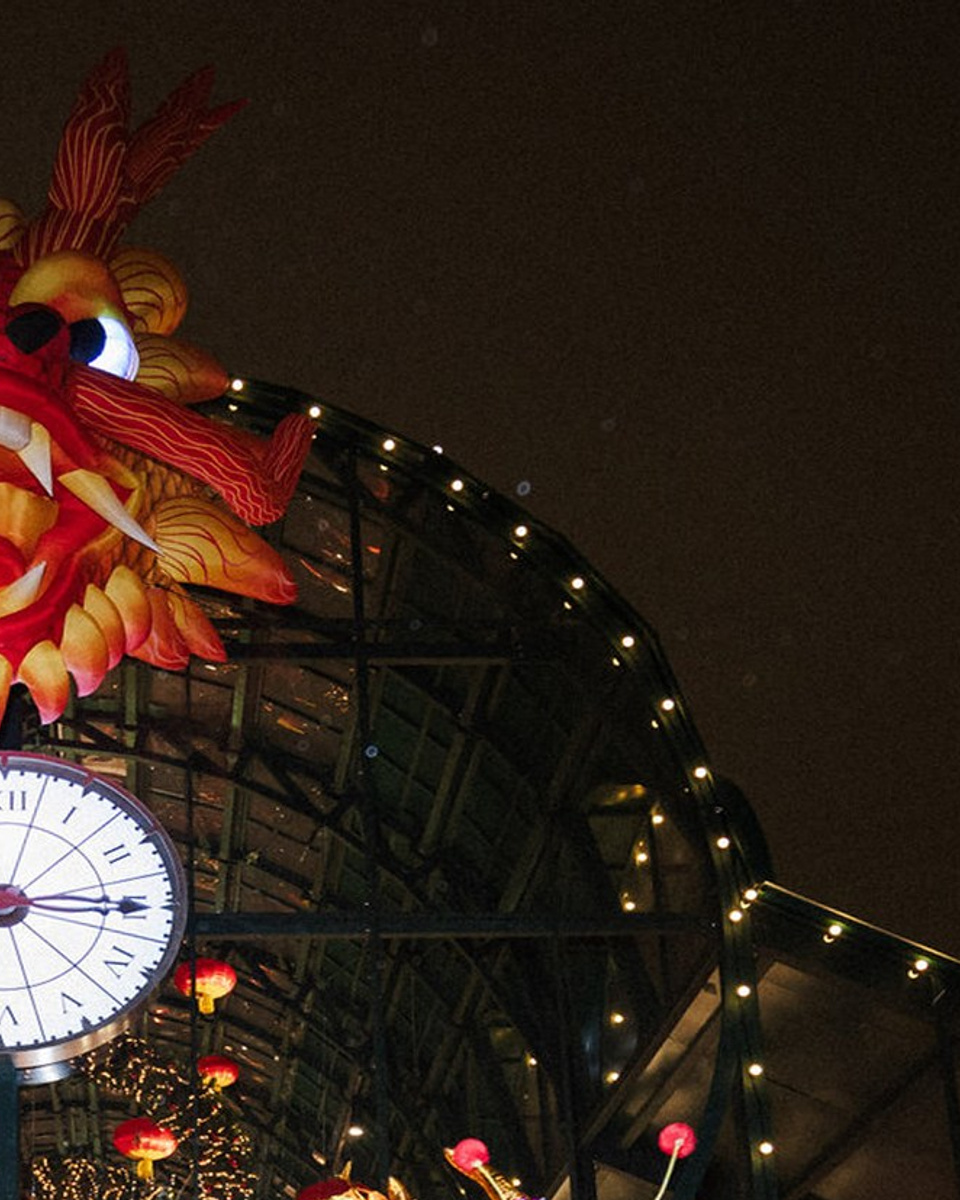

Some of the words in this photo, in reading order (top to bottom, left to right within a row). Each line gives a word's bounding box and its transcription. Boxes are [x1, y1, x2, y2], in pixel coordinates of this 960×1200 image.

[62, 806, 77, 825] I
[102, 843, 131, 865] II
[102, 945, 135, 980] IV
[60, 991, 85, 1015] V
